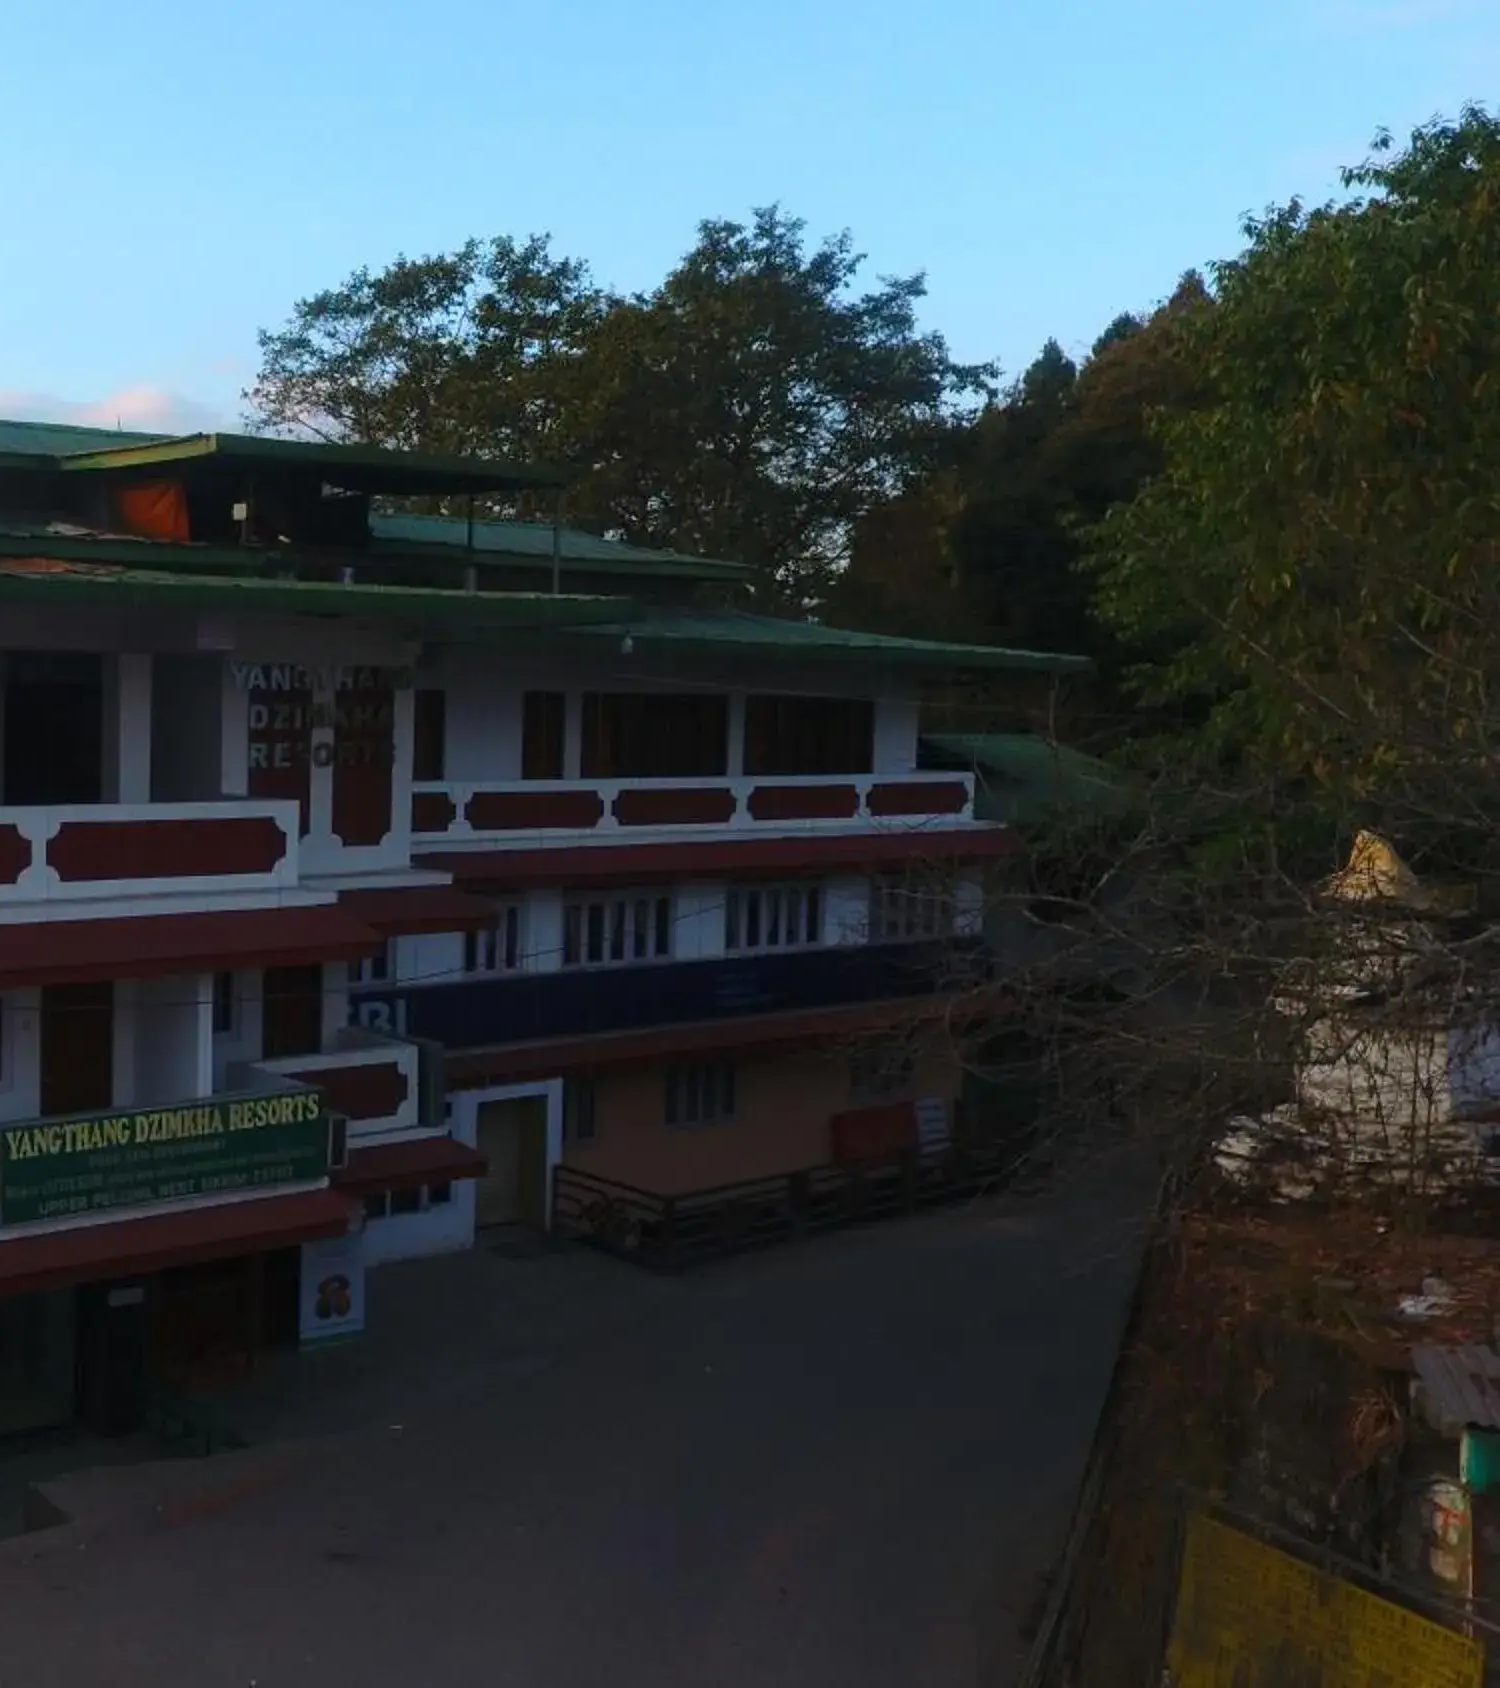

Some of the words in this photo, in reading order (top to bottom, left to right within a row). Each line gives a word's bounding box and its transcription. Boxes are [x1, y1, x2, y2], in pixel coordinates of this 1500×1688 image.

[349, 998, 407, 1038] BI
[5, 1117, 130, 1160] YANGTHANG
[135, 1105, 224, 1144] DZIMKHA
[229, 1093, 320, 1132] RESORTS
